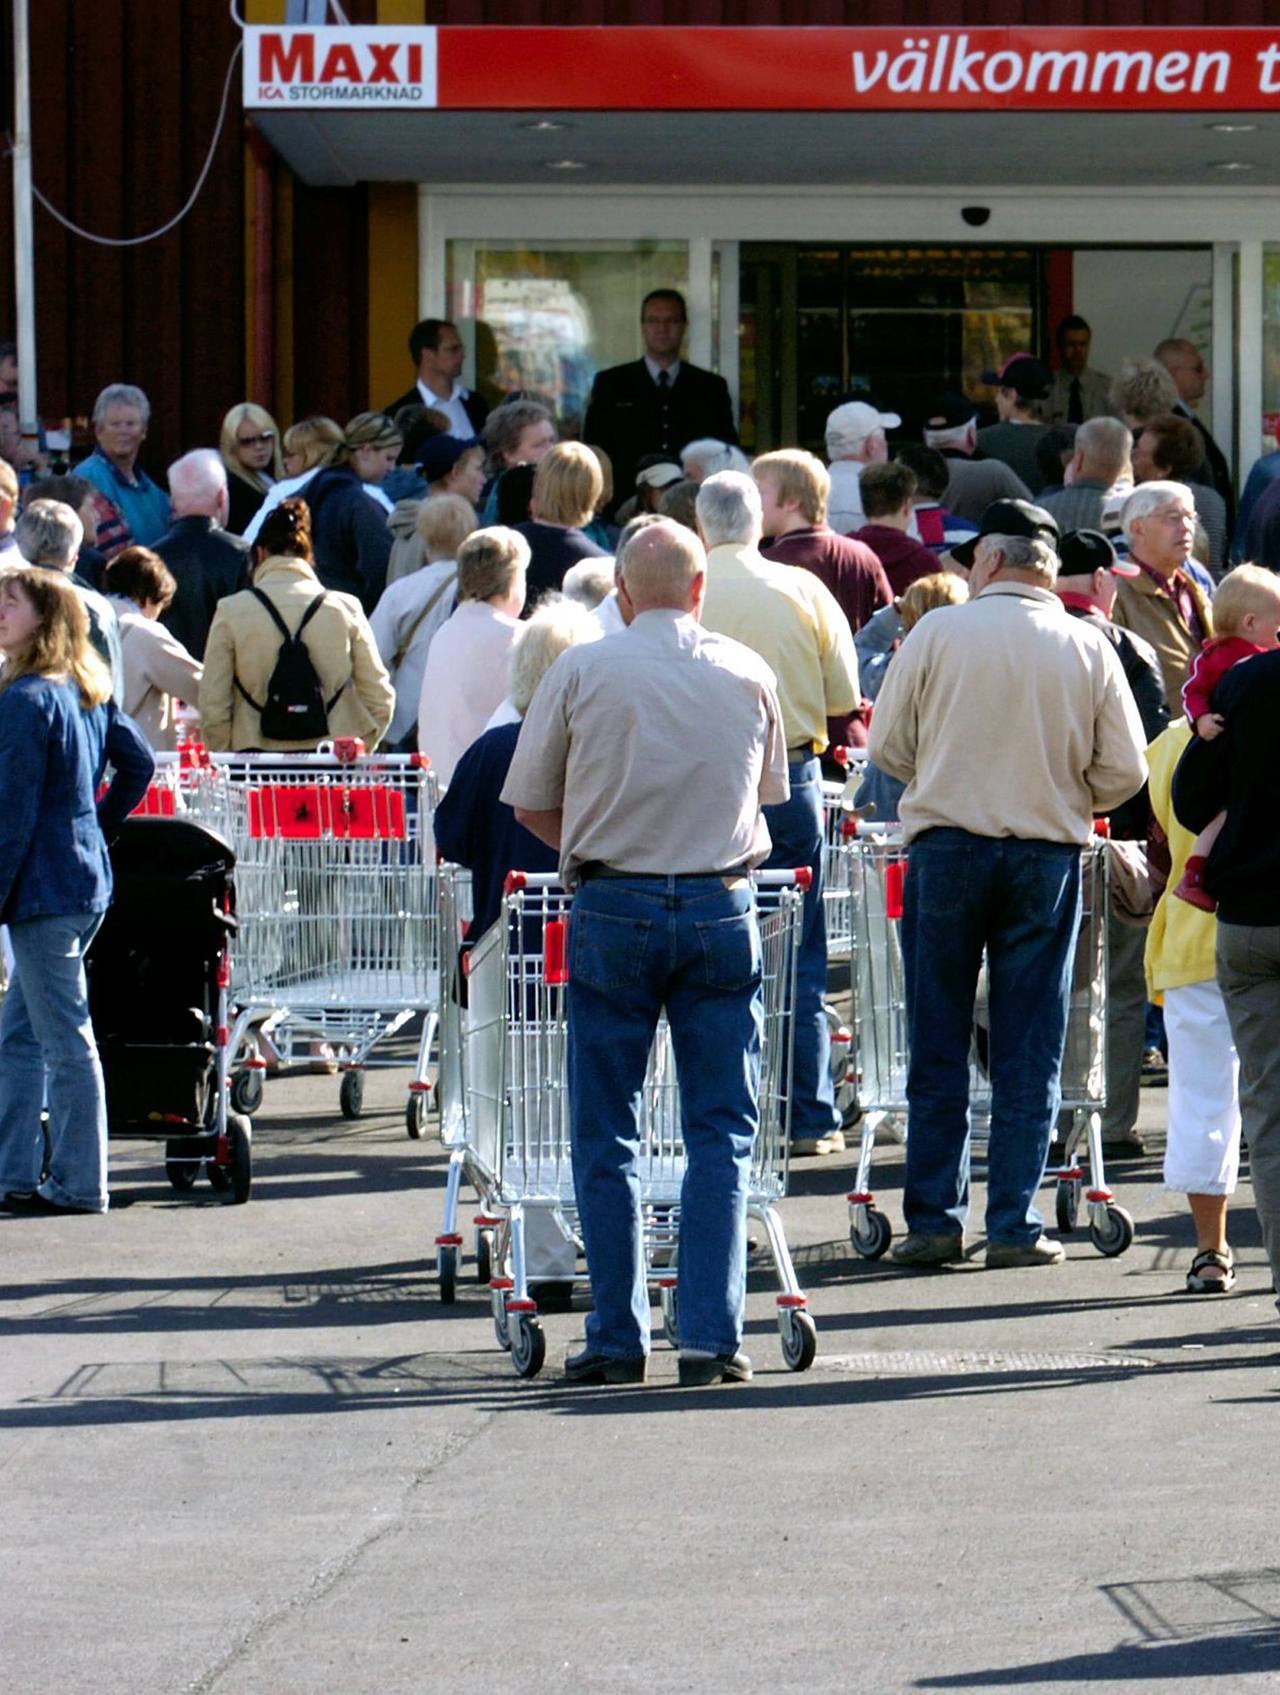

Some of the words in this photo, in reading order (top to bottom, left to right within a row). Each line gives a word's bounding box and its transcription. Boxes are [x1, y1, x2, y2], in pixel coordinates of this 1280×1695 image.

[259, 33, 422, 83] MAXI
[852, 34, 1231, 93] välkommen
[258, 86, 284, 99] ICA
[289, 86, 422, 100] STORMARKNAD
